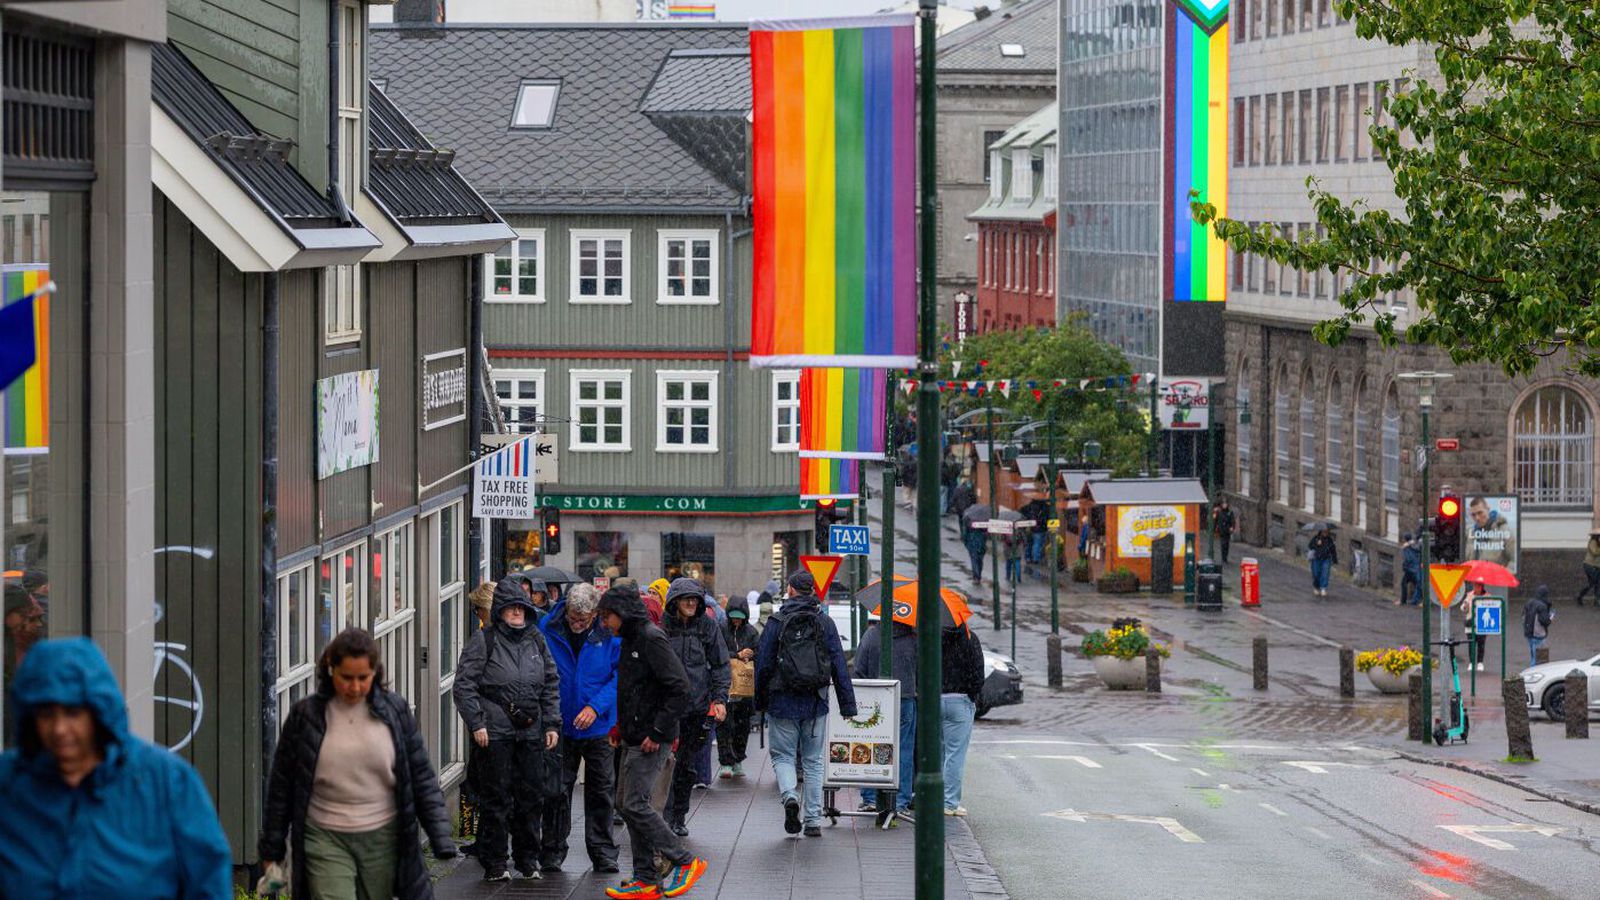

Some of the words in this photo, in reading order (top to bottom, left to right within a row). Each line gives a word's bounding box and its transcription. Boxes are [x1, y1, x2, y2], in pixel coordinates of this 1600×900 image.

[481, 480, 500, 493] TAX
[504, 480, 528, 494] FREE
[480, 494, 528, 508] SHOPPING
[563, 496, 627, 509] STORE
[655, 497, 707, 510] .COM
[480, 508, 494, 516] SAVE
[832, 528, 867, 545] TAXI
[1473, 539, 1505, 551] haust
